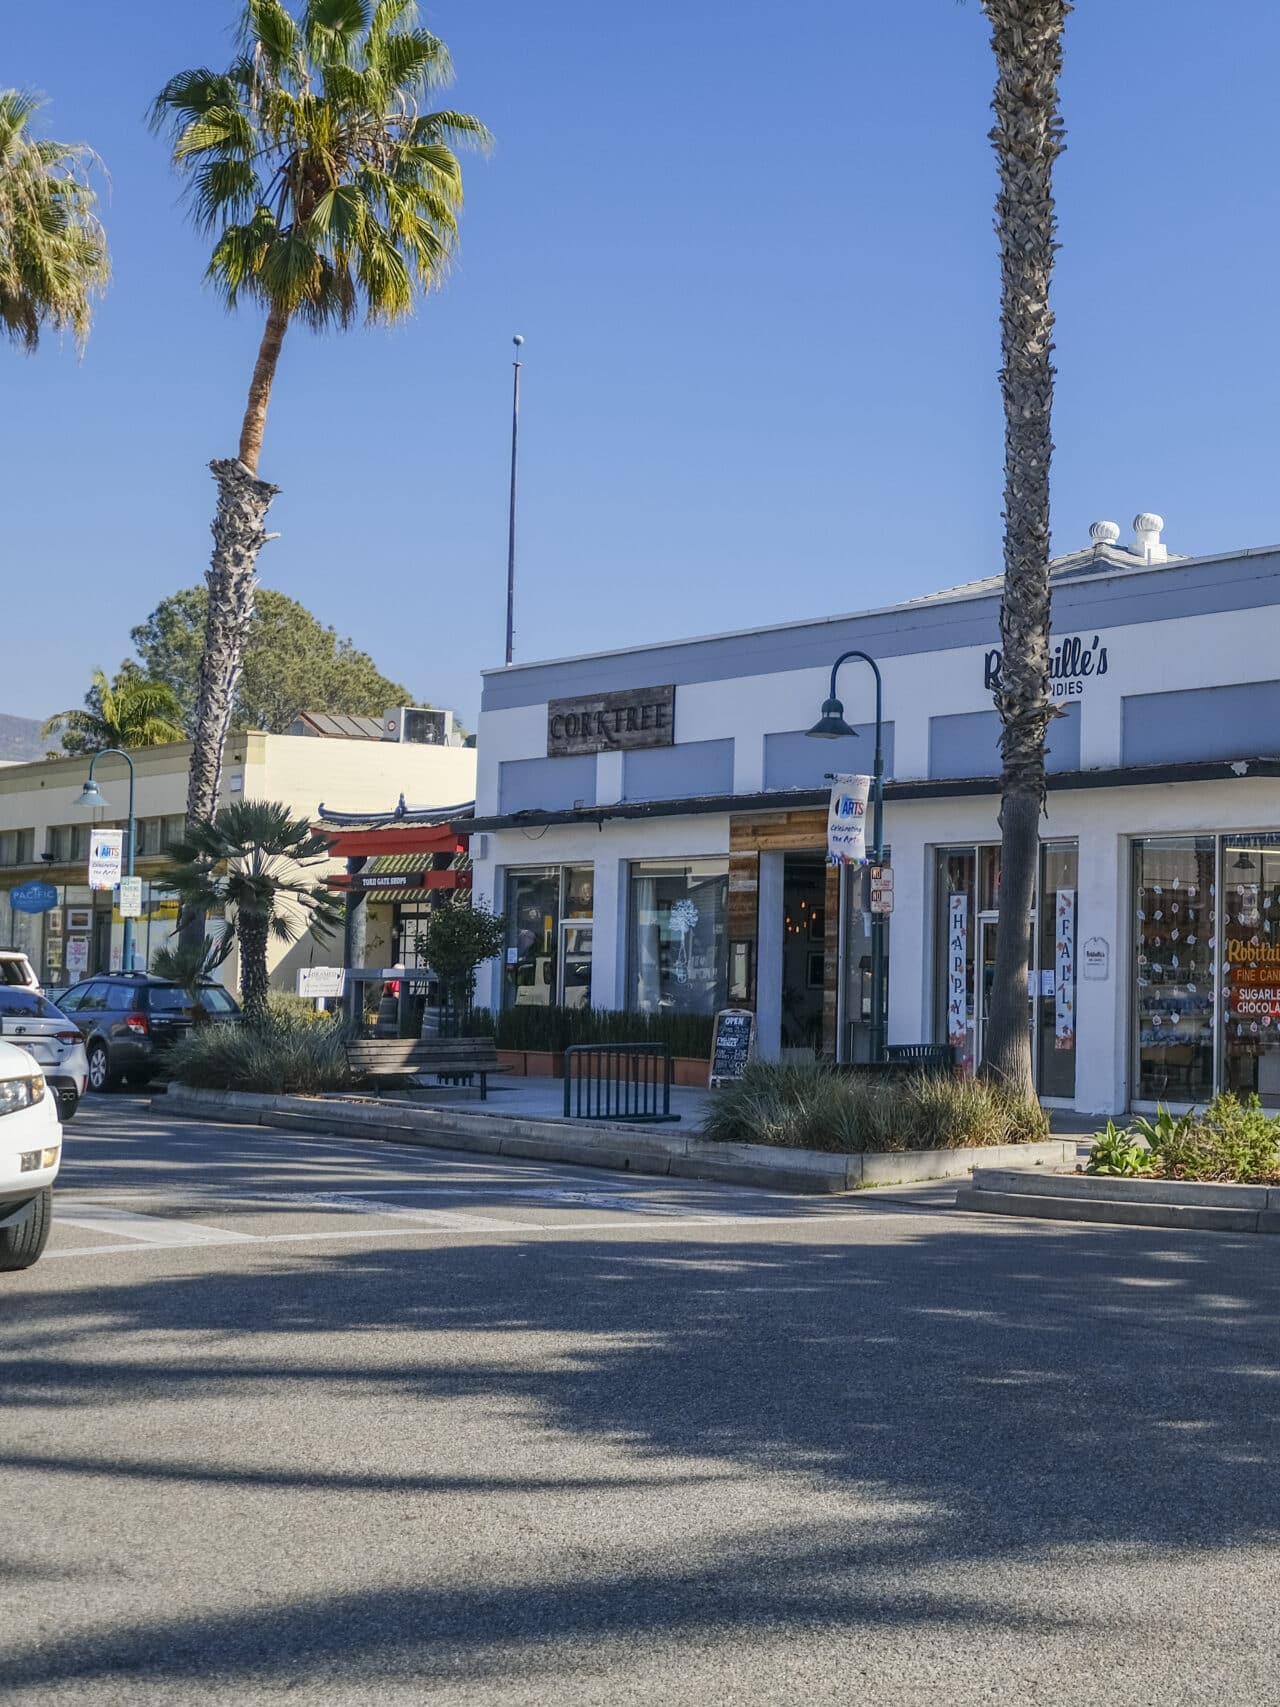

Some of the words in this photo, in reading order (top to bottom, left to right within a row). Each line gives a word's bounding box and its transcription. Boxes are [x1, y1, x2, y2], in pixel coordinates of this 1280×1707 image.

[872, 869, 881, 879] NO
[872, 891, 881, 901] NO
[954, 914, 963, 1015] HAPPY
[1061, 919, 1071, 1004] FALL
[1236, 969, 1256, 980] FINE
[725, 1017, 744, 1025] OPEN
